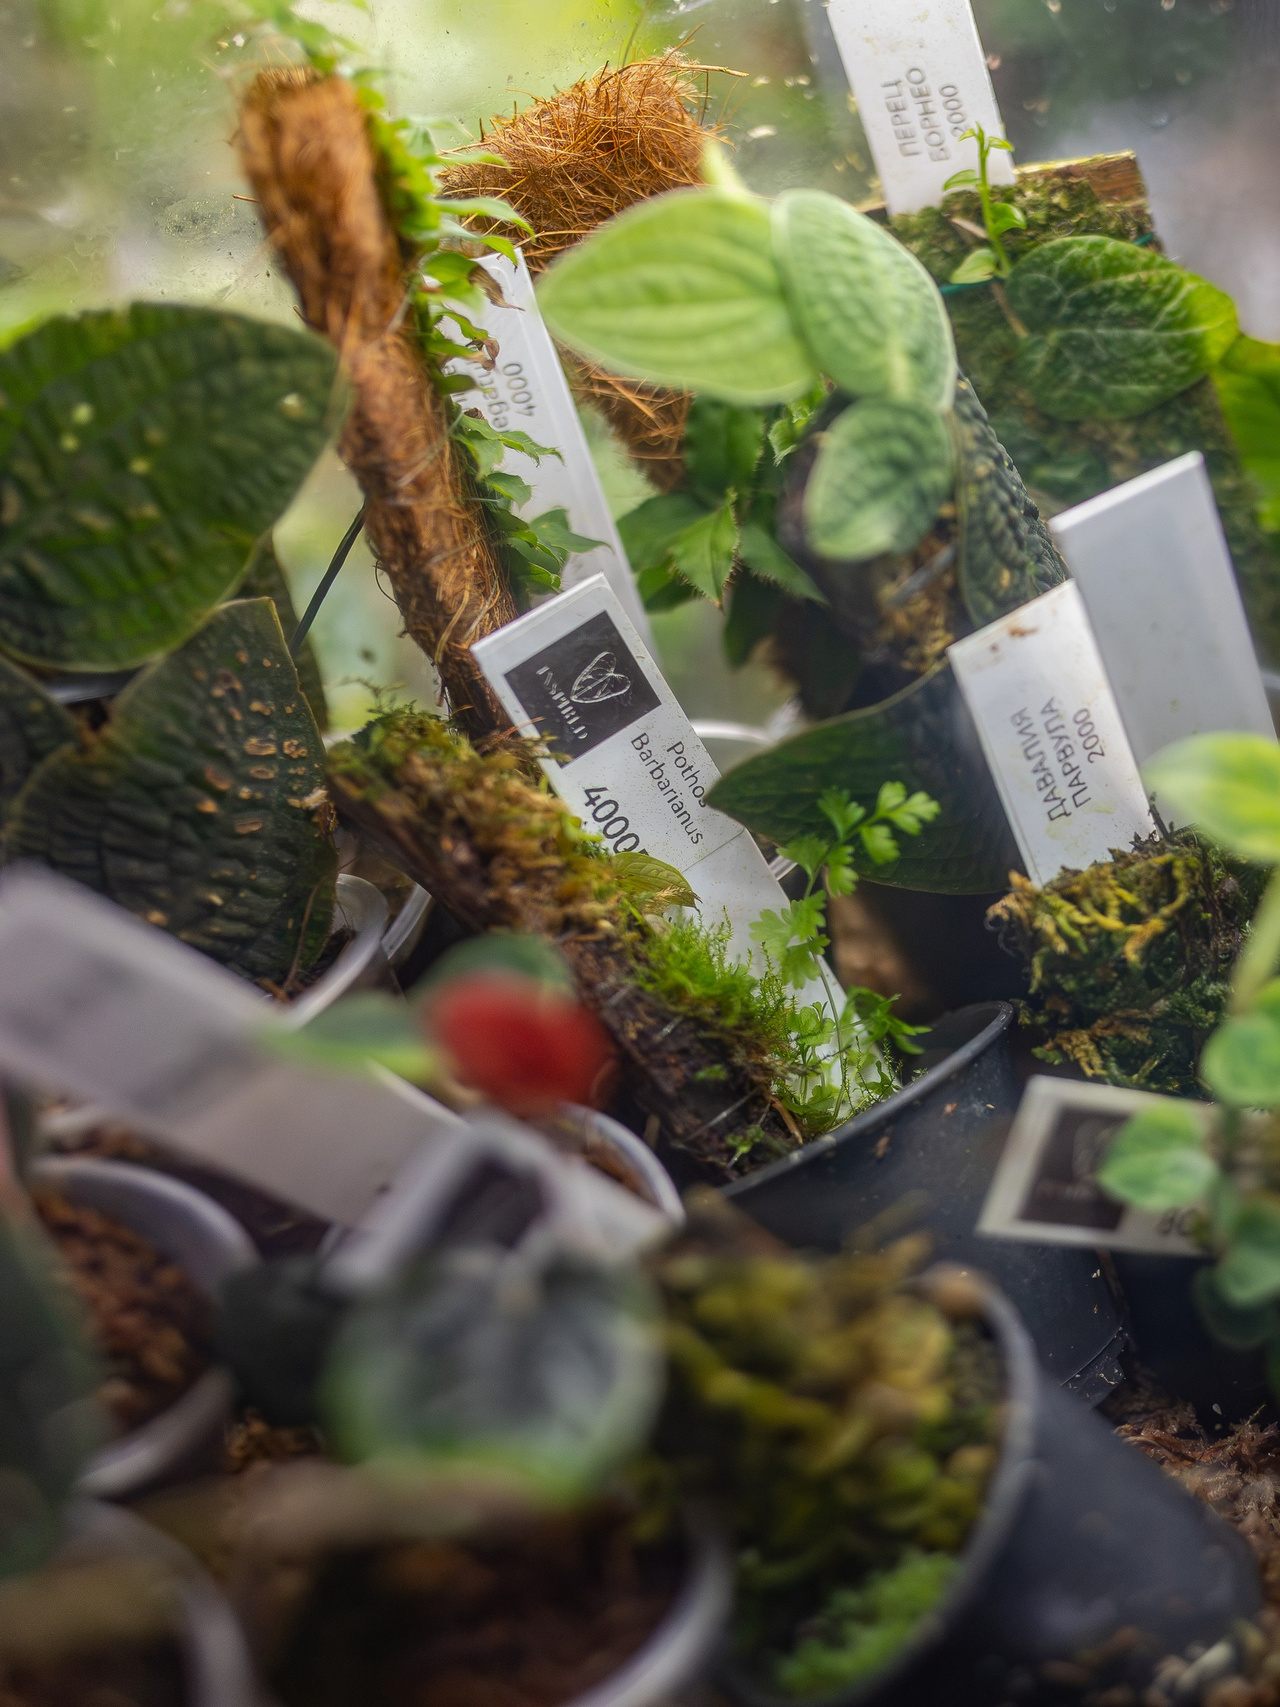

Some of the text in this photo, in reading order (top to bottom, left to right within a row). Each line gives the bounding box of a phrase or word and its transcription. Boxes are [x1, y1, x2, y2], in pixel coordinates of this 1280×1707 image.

[881, 79, 921, 157] ПЕРЕЦ
[905, 67, 949, 162] БОРНЕО
[939, 85, 970, 137] 2000
[503, 363, 536, 416] 4000
[535, 665, 588, 740] INSPIRED
[1073, 708, 1105, 764] 2000
[631, 732, 704, 845] Barbarianus
[1010, 706, 1072, 822] ДАВАЛИЯ
[1040, 697, 1092, 808] ПАРВУЛА
